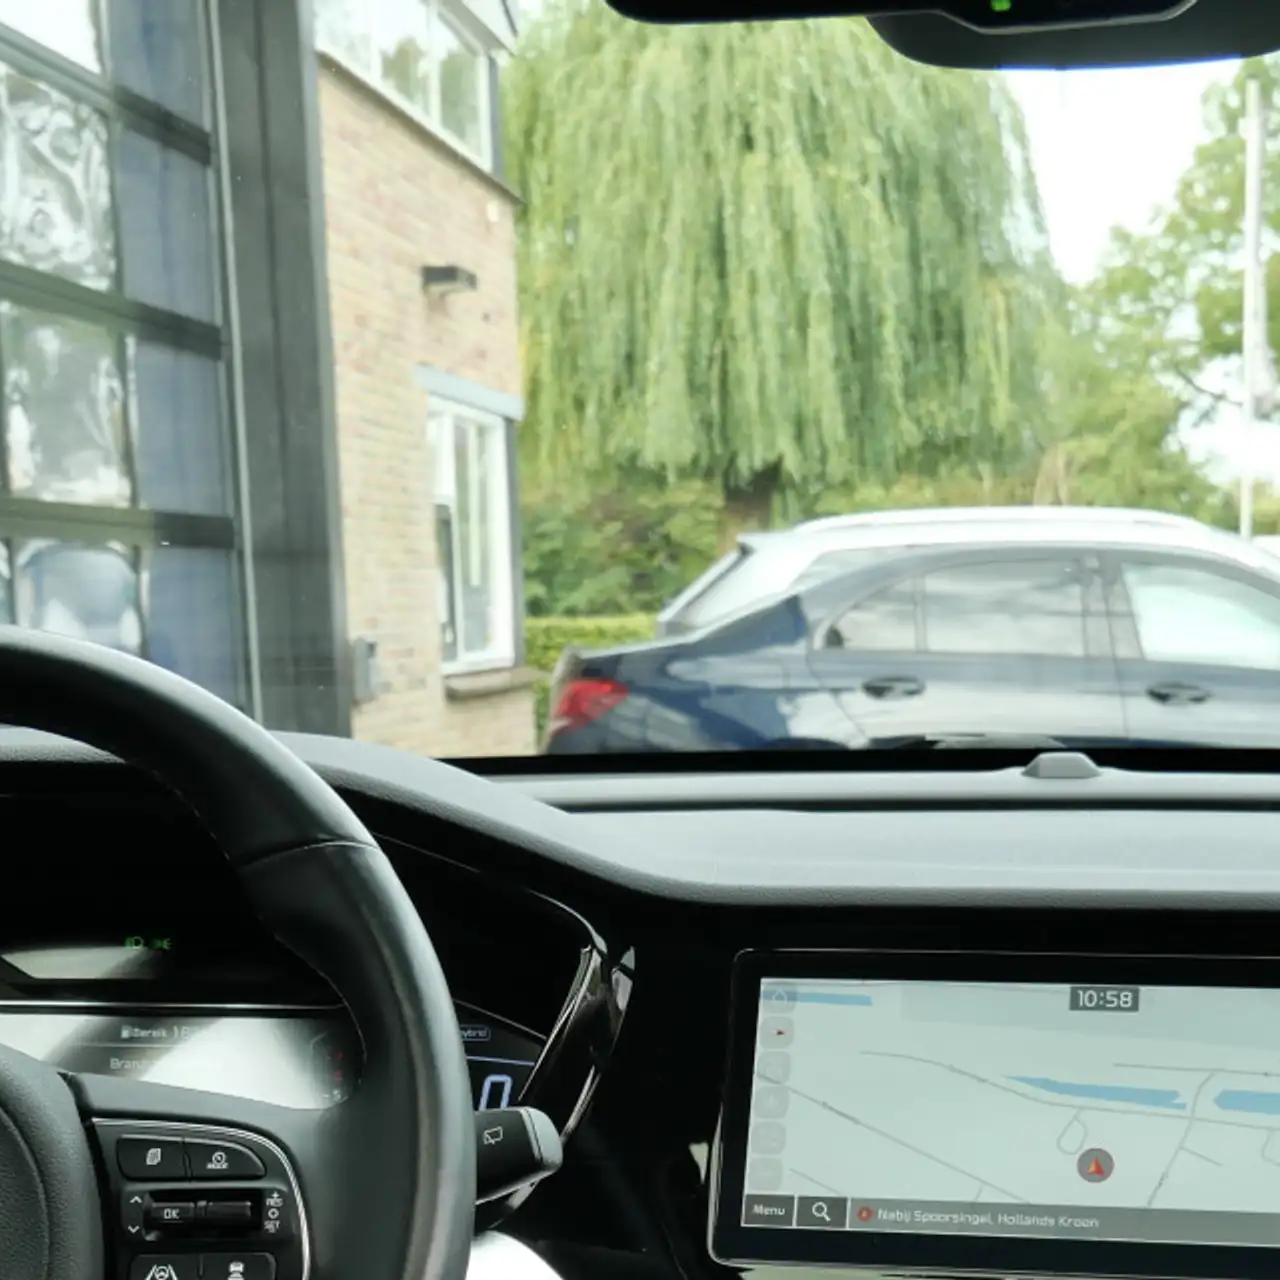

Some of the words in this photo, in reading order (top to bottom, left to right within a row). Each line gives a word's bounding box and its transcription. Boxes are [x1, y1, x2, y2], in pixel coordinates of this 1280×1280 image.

[1077, 989, 1133, 1009] 10:58
[163, 1208, 180, 1219] OK
[752, 1203, 786, 1216] Menu
[1058, 1216, 1100, 1229] Kroon
